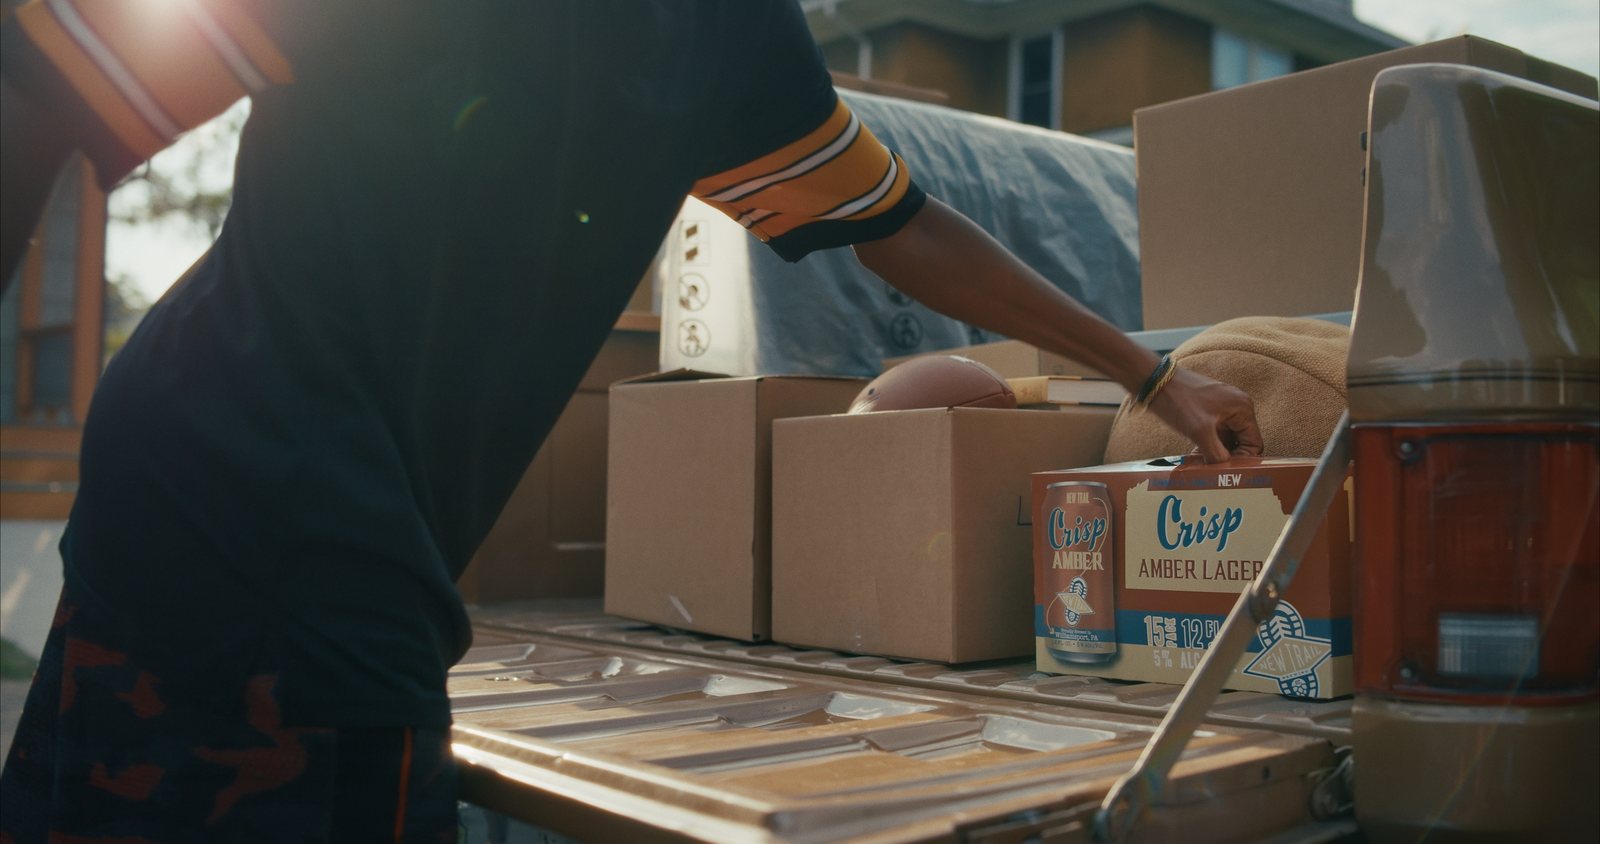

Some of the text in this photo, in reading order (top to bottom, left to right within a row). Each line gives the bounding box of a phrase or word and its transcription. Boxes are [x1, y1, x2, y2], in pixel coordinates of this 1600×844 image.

[1218, 474, 1242, 487] NEW
[1066, 492, 1090, 504] NEW TRAIL
[1049, 507, 1106, 551] Crisp
[1157, 494, 1244, 552] Crisp
[1052, 551, 1104, 570] AMBER
[1138, 558, 1264, 581] AMBER LAGER
[1143, 615, 1177, 648] 15 PACK
[1181, 618, 1220, 649] 12 FL
[1153, 650, 1172, 669] 5%
[1260, 643, 1322, 672] NEW TRAIL
